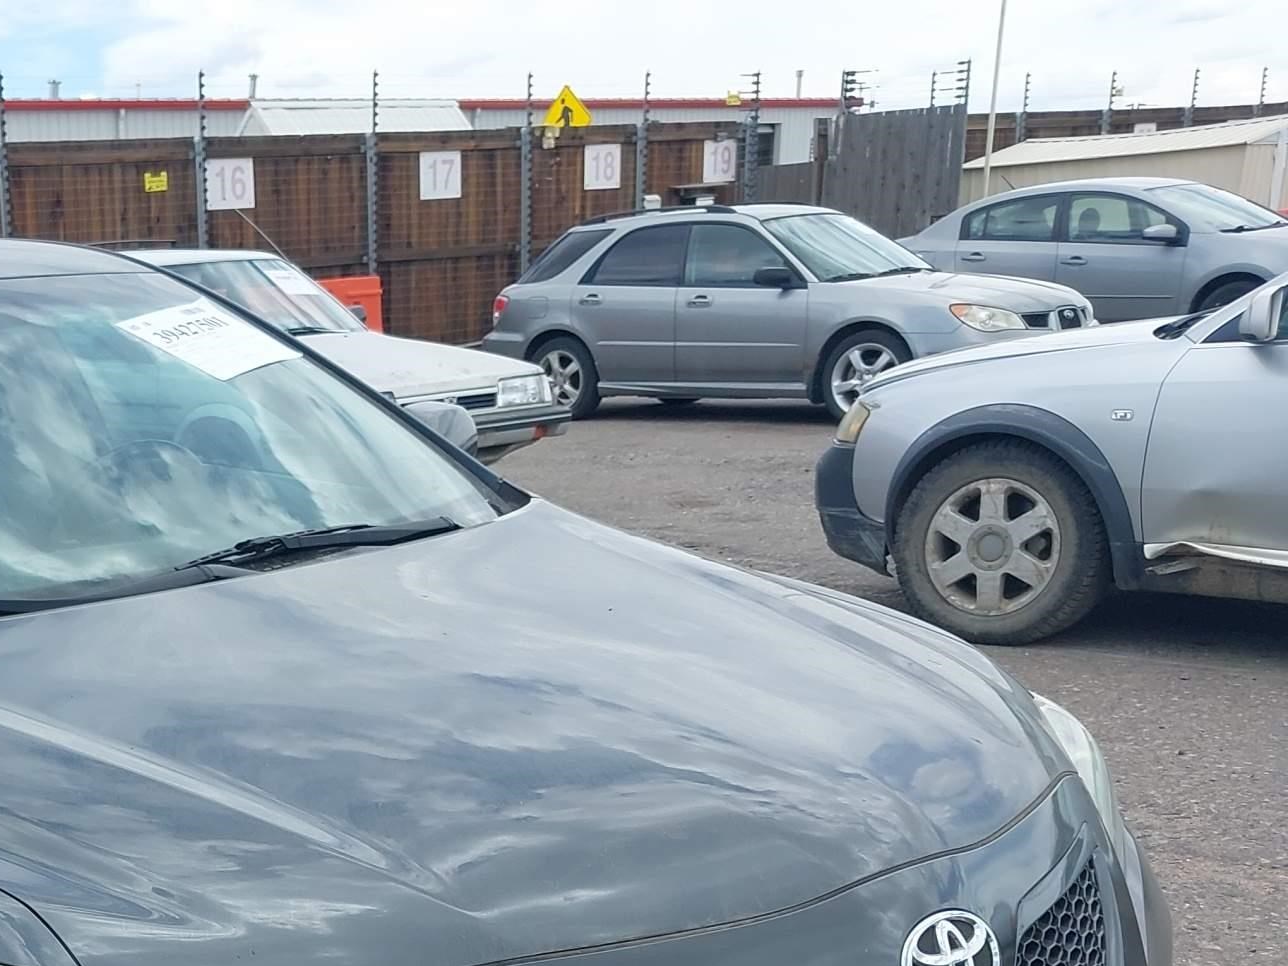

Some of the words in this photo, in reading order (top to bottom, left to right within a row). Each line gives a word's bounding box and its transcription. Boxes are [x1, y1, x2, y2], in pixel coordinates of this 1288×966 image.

[427, 159, 455, 191] 17
[592, 151, 615, 181] 18
[711, 145, 731, 175] 19
[216, 165, 246, 201] 16
